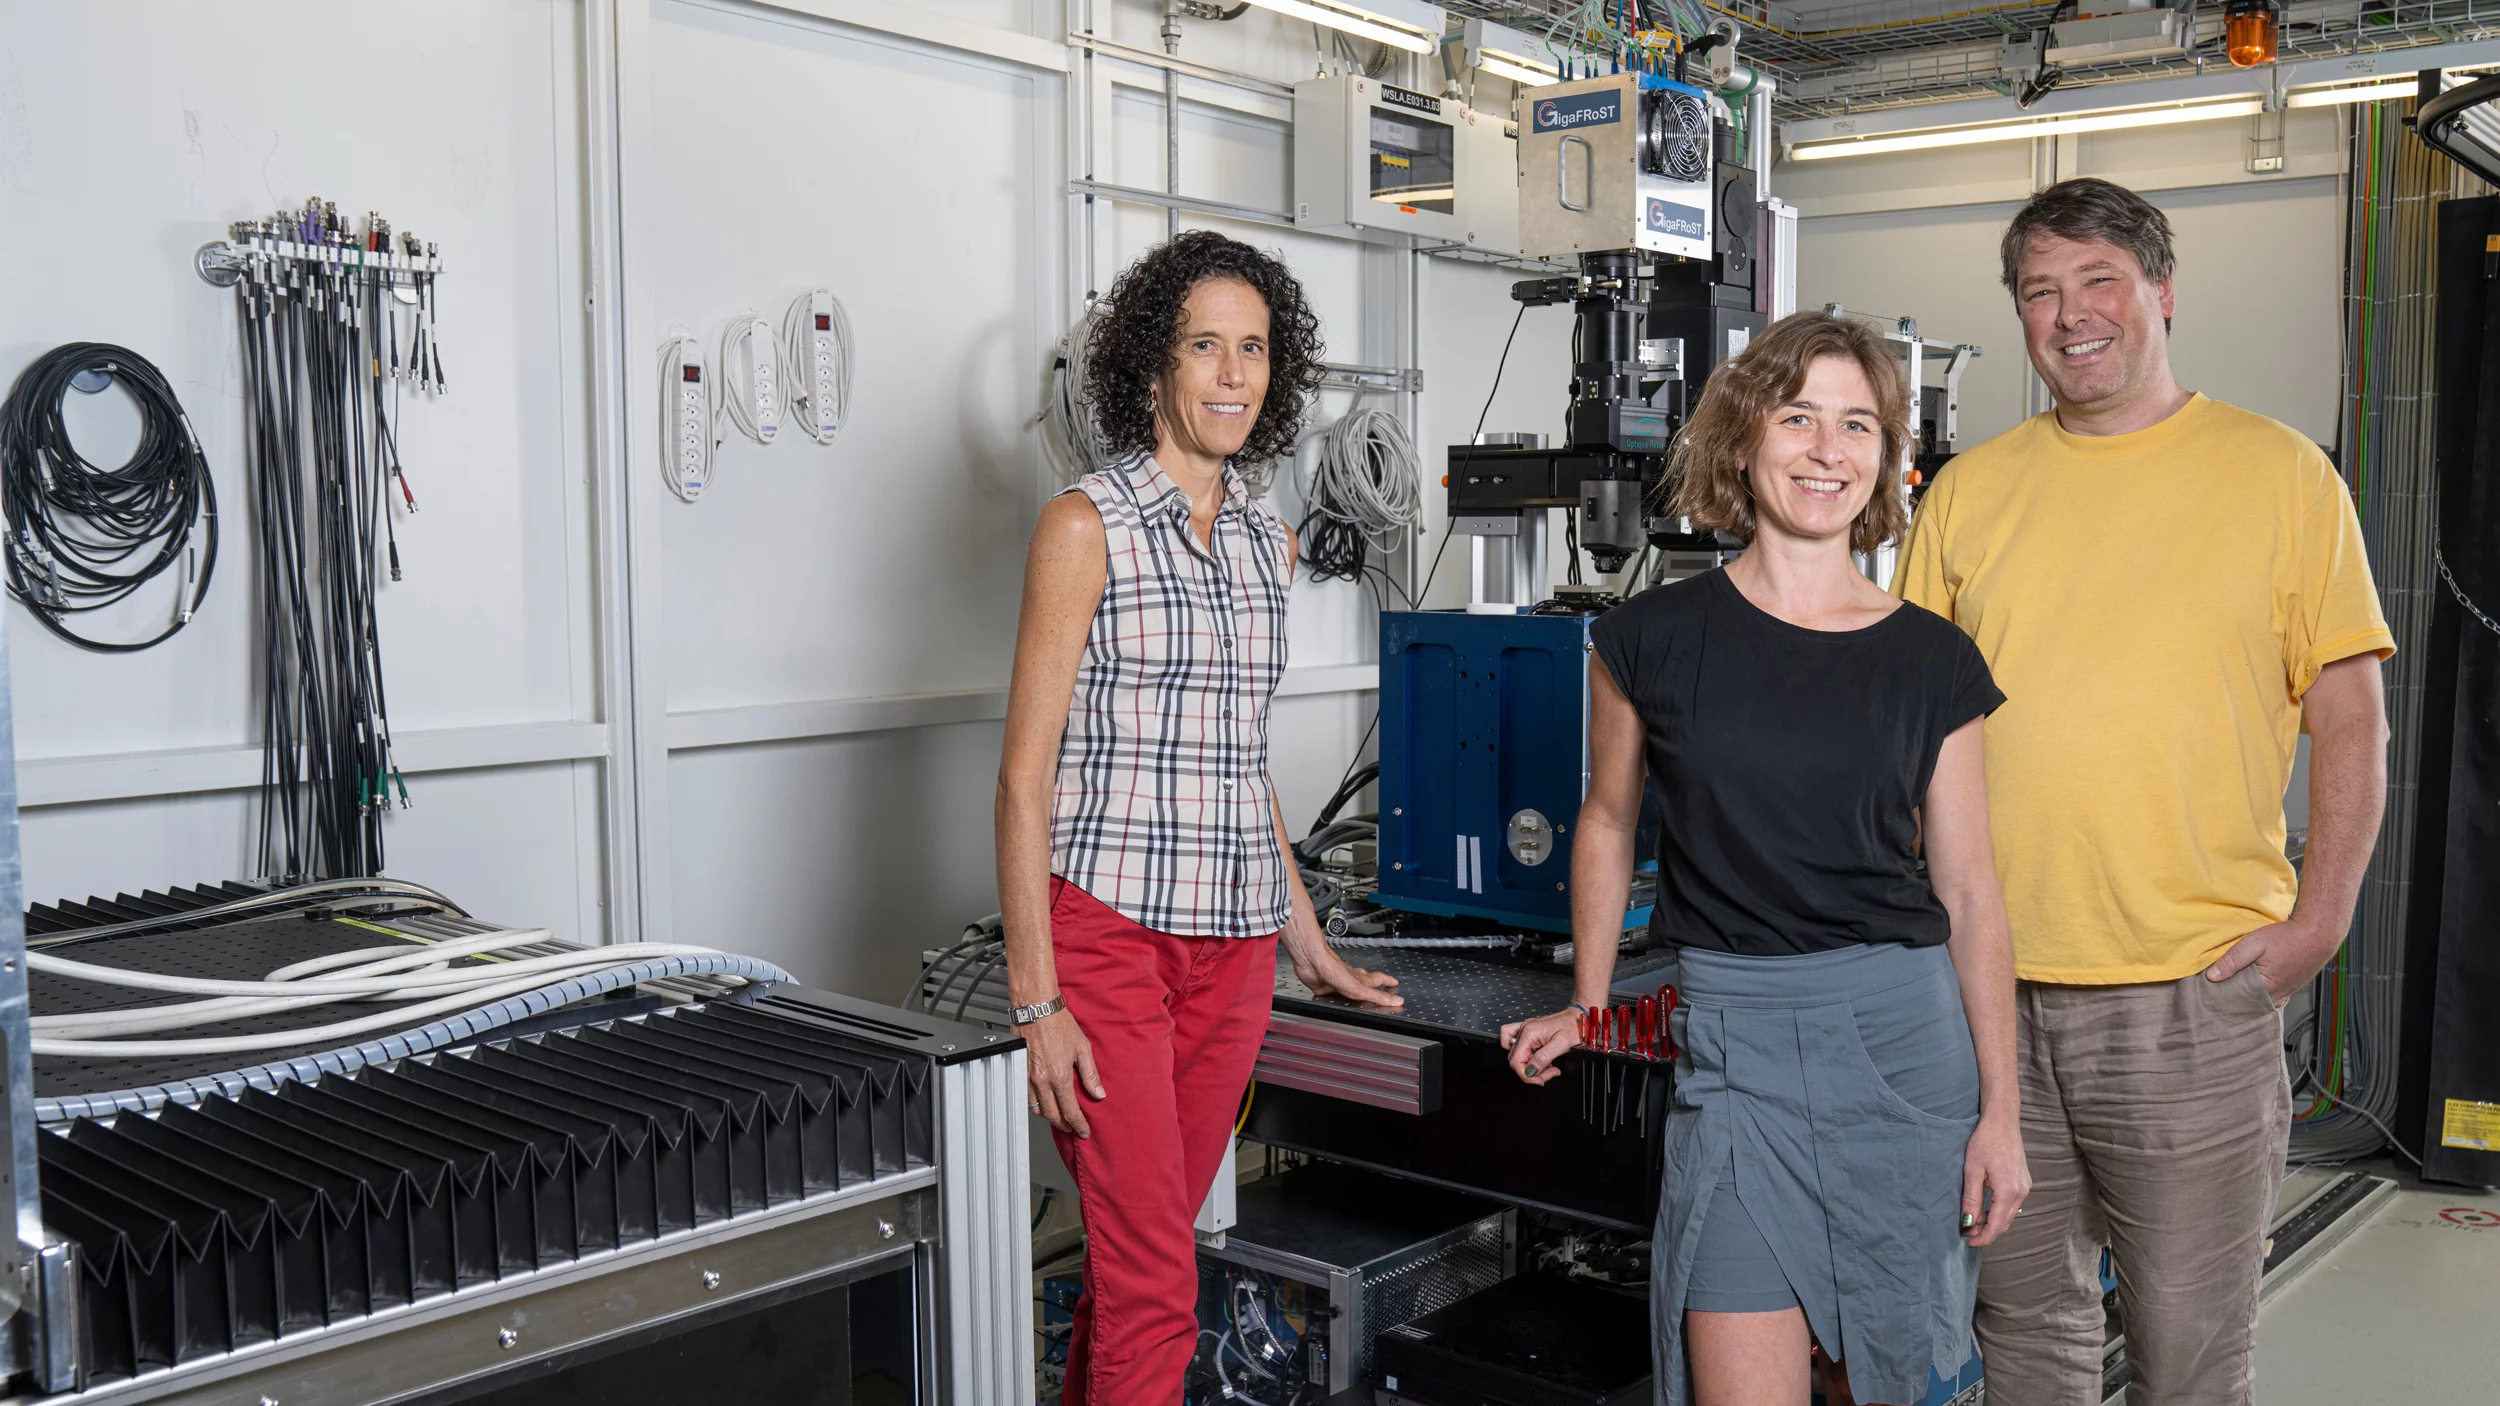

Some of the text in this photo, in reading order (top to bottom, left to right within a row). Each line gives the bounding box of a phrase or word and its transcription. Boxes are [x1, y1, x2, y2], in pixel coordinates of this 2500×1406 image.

[1382, 88, 1440, 112] WSLA.E031.3.03
[1537, 101, 1616, 127] GigaFRoST
[1649, 201, 1702, 235] GigaFRoST
[1626, 438, 1649, 450] Optique
